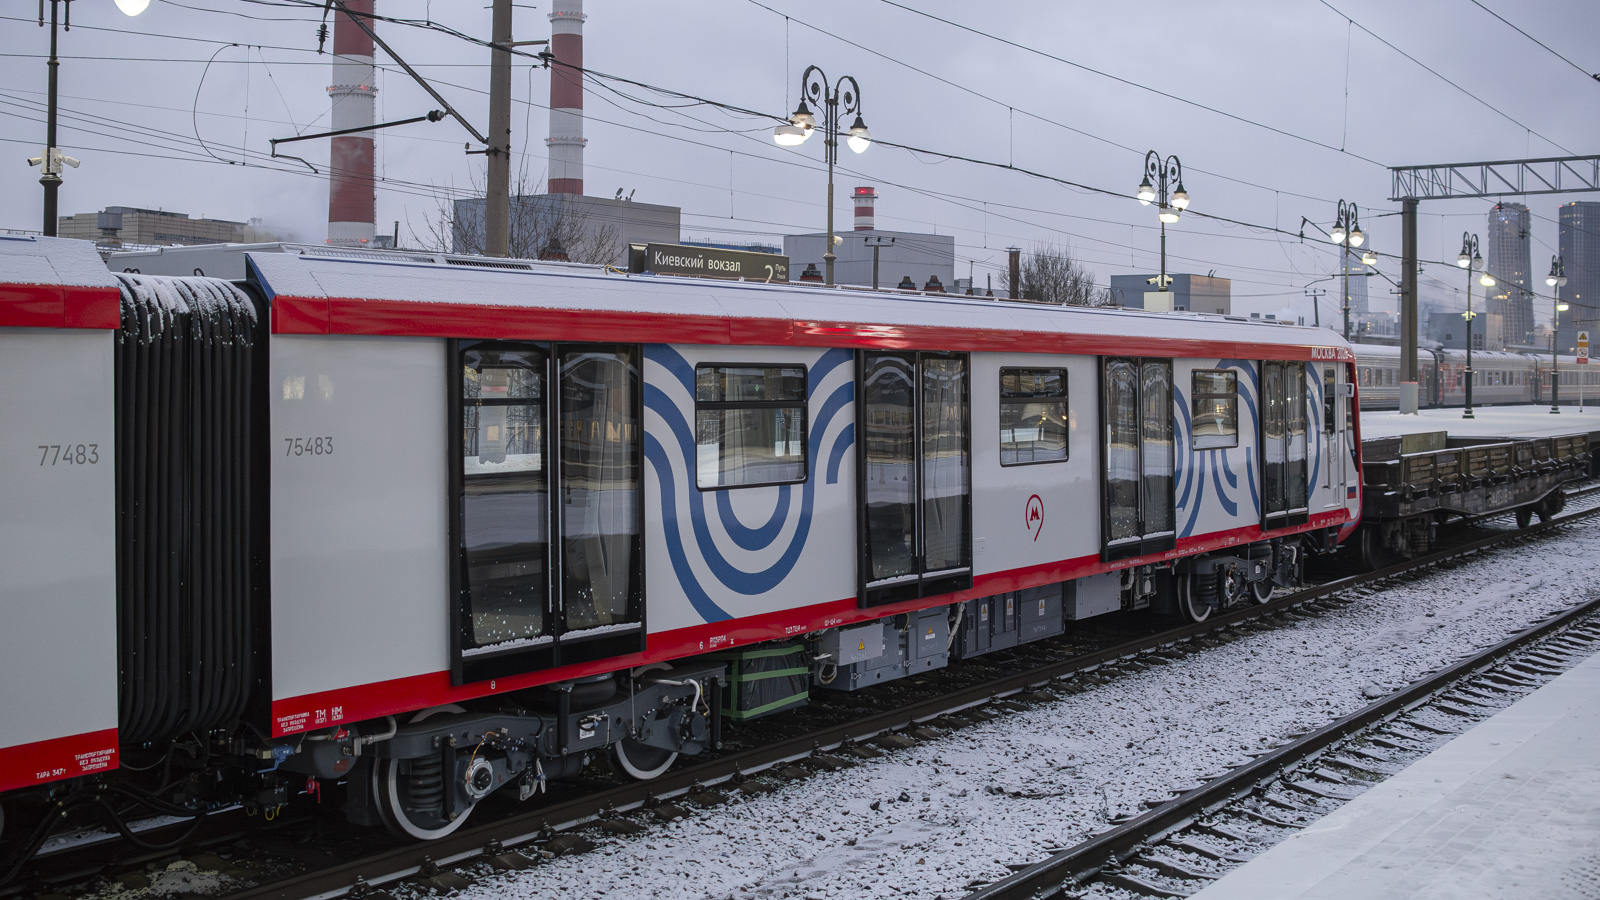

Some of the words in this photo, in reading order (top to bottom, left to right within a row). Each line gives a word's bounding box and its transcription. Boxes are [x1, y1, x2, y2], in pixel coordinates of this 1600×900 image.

[654, 251, 703, 268] Киевский
[708, 258, 741, 272] вокзал
[765, 264, 774, 283] 2
[775, 263, 786, 273] Путь
[1311, 347, 1335, 359] МОСКВА
[284, 436, 334, 457] 75483
[38, 444, 99, 466] 77483
[699, 641, 704, 650] 6
[490, 680, 496, 690] 8
[315, 709, 327, 718] ТМ
[36, 771, 50, 779] ТАРА
